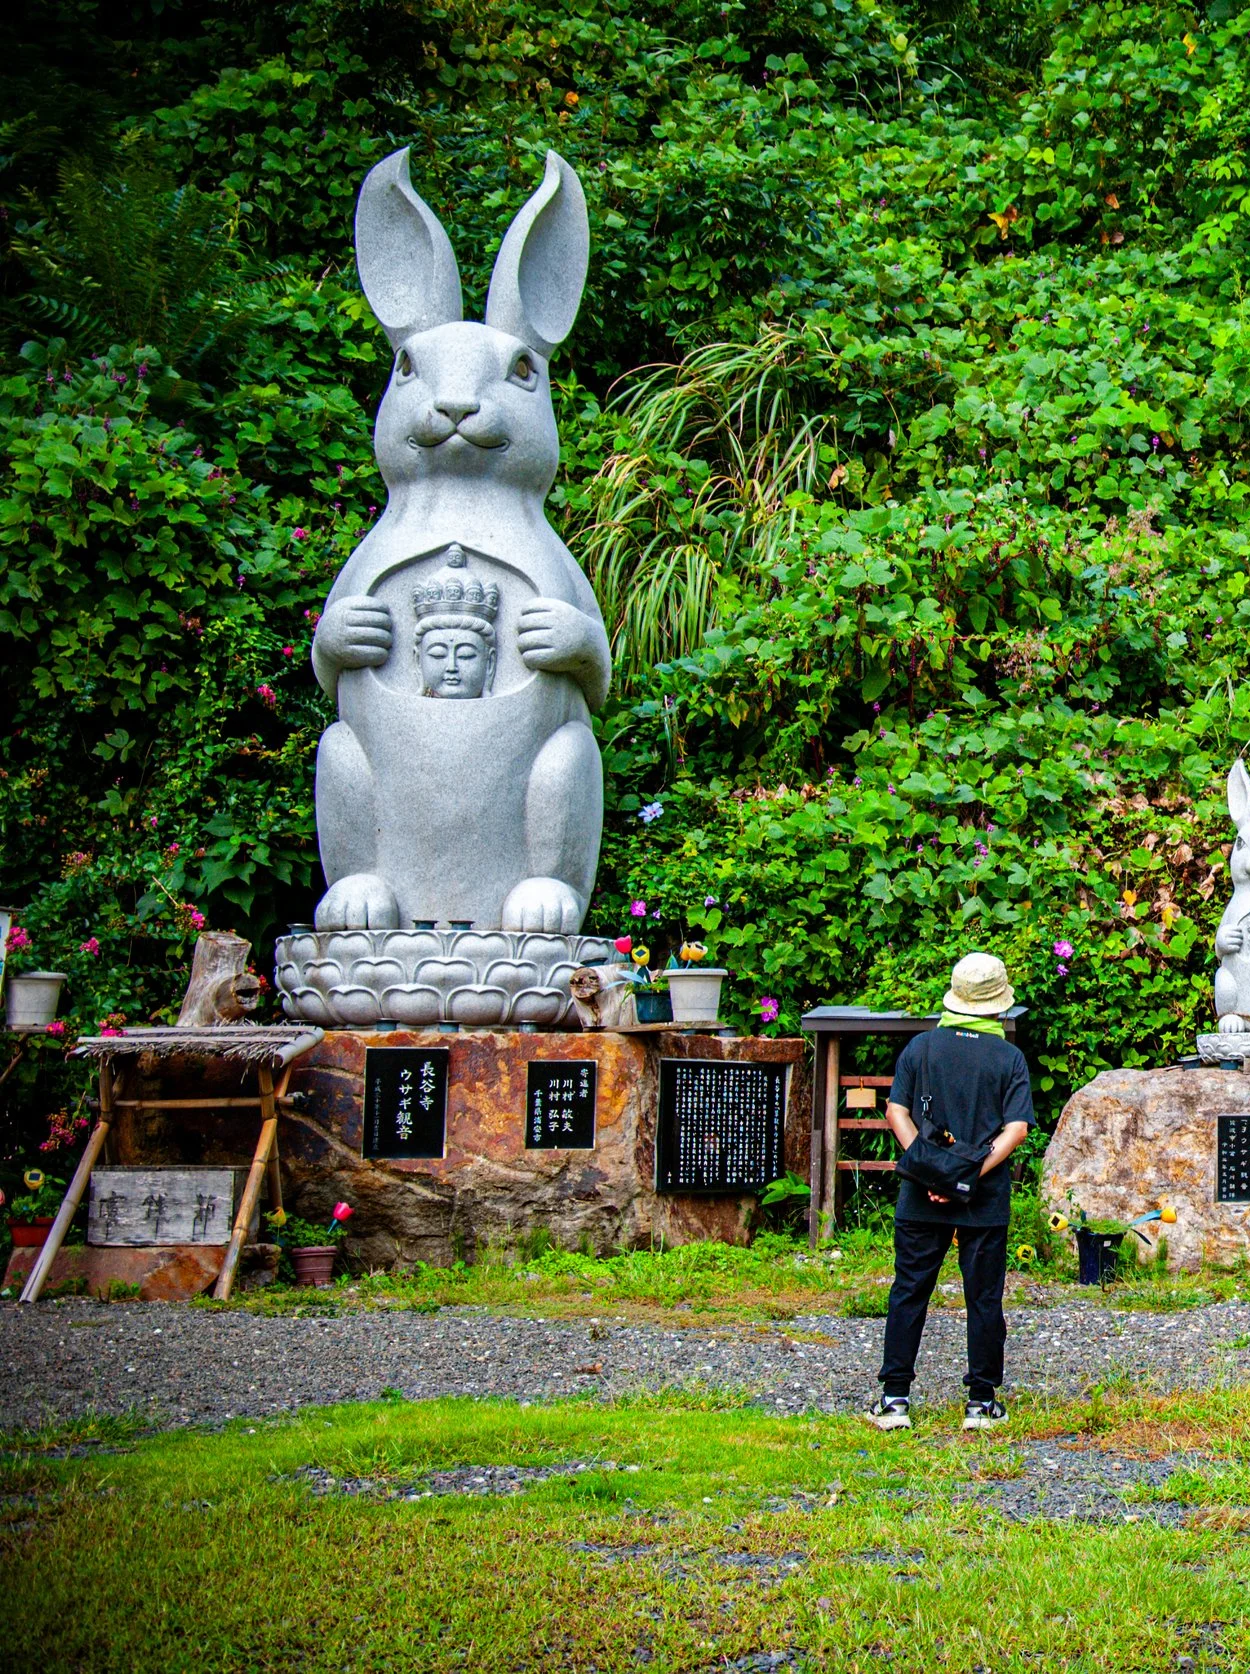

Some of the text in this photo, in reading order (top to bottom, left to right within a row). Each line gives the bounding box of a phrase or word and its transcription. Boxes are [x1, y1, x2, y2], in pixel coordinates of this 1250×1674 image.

[395, 1069, 413, 1141] ウサギ観音
[419, 1061, 437, 1111] 長谷寺
[548, 1079, 561, 1132] 川村 弘子
[562, 1079, 575, 1102] 川村
